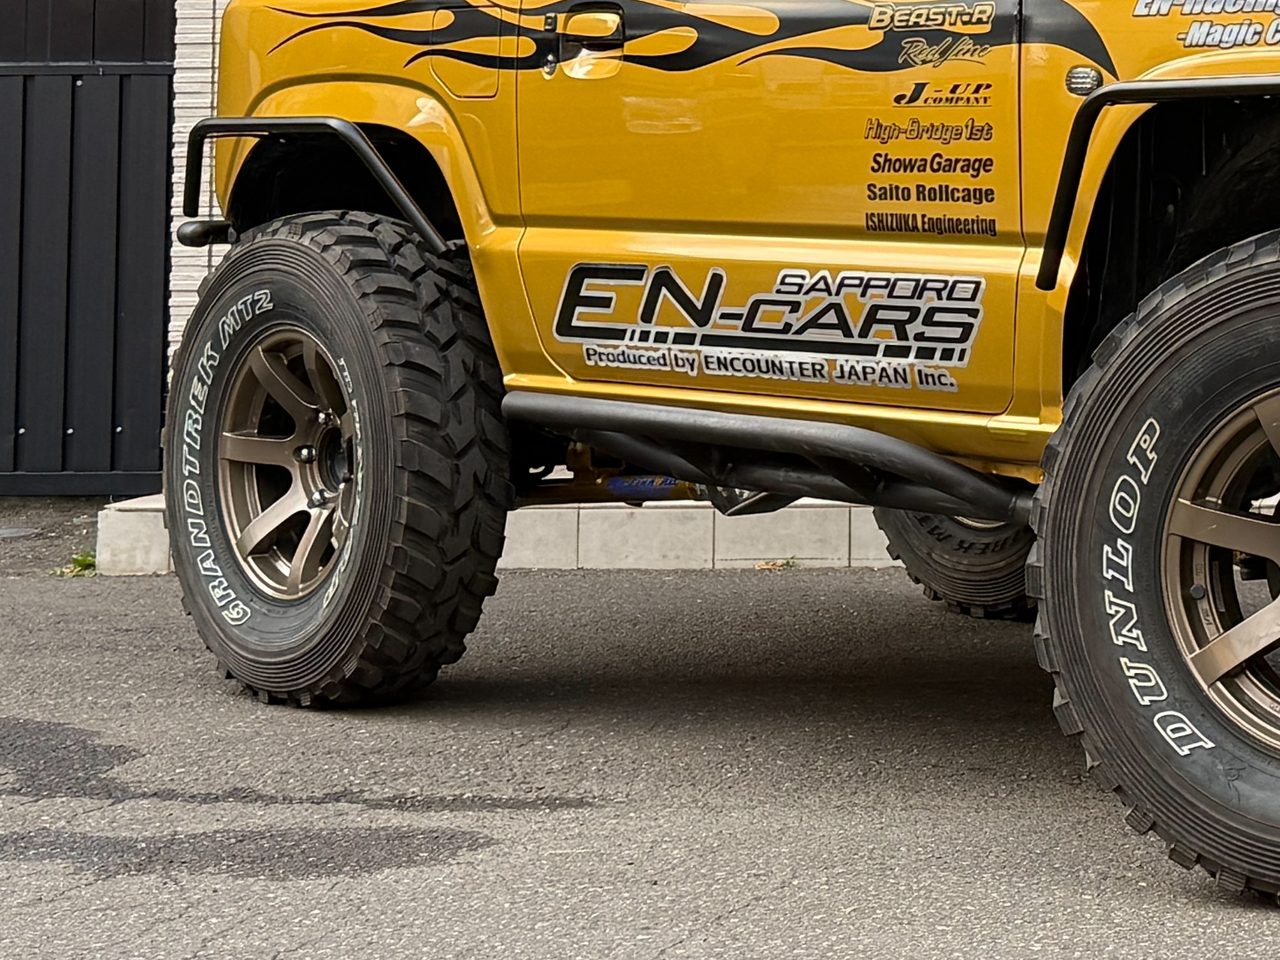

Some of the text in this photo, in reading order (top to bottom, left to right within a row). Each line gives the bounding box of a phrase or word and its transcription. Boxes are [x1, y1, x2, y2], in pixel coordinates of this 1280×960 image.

[923, 96, 992, 105] COMPANY
[963, 118, 993, 141] 1st
[871, 153, 994, 178] Showa Garage
[867, 183, 995, 205] Saito Rollcage
[865, 212, 997, 236] ISHIZUKA Engineering
[776, 272, 982, 301] SAPPORO
[554, 263, 982, 344] EN-CARS
[584, 346, 958, 390] Produced by ENCOUNTER JAPAN Inc.
[181, 341, 252, 626] GRANDTREK
[218, 289, 275, 351] MT2
[1102, 417, 1216, 756] DUNLOP
